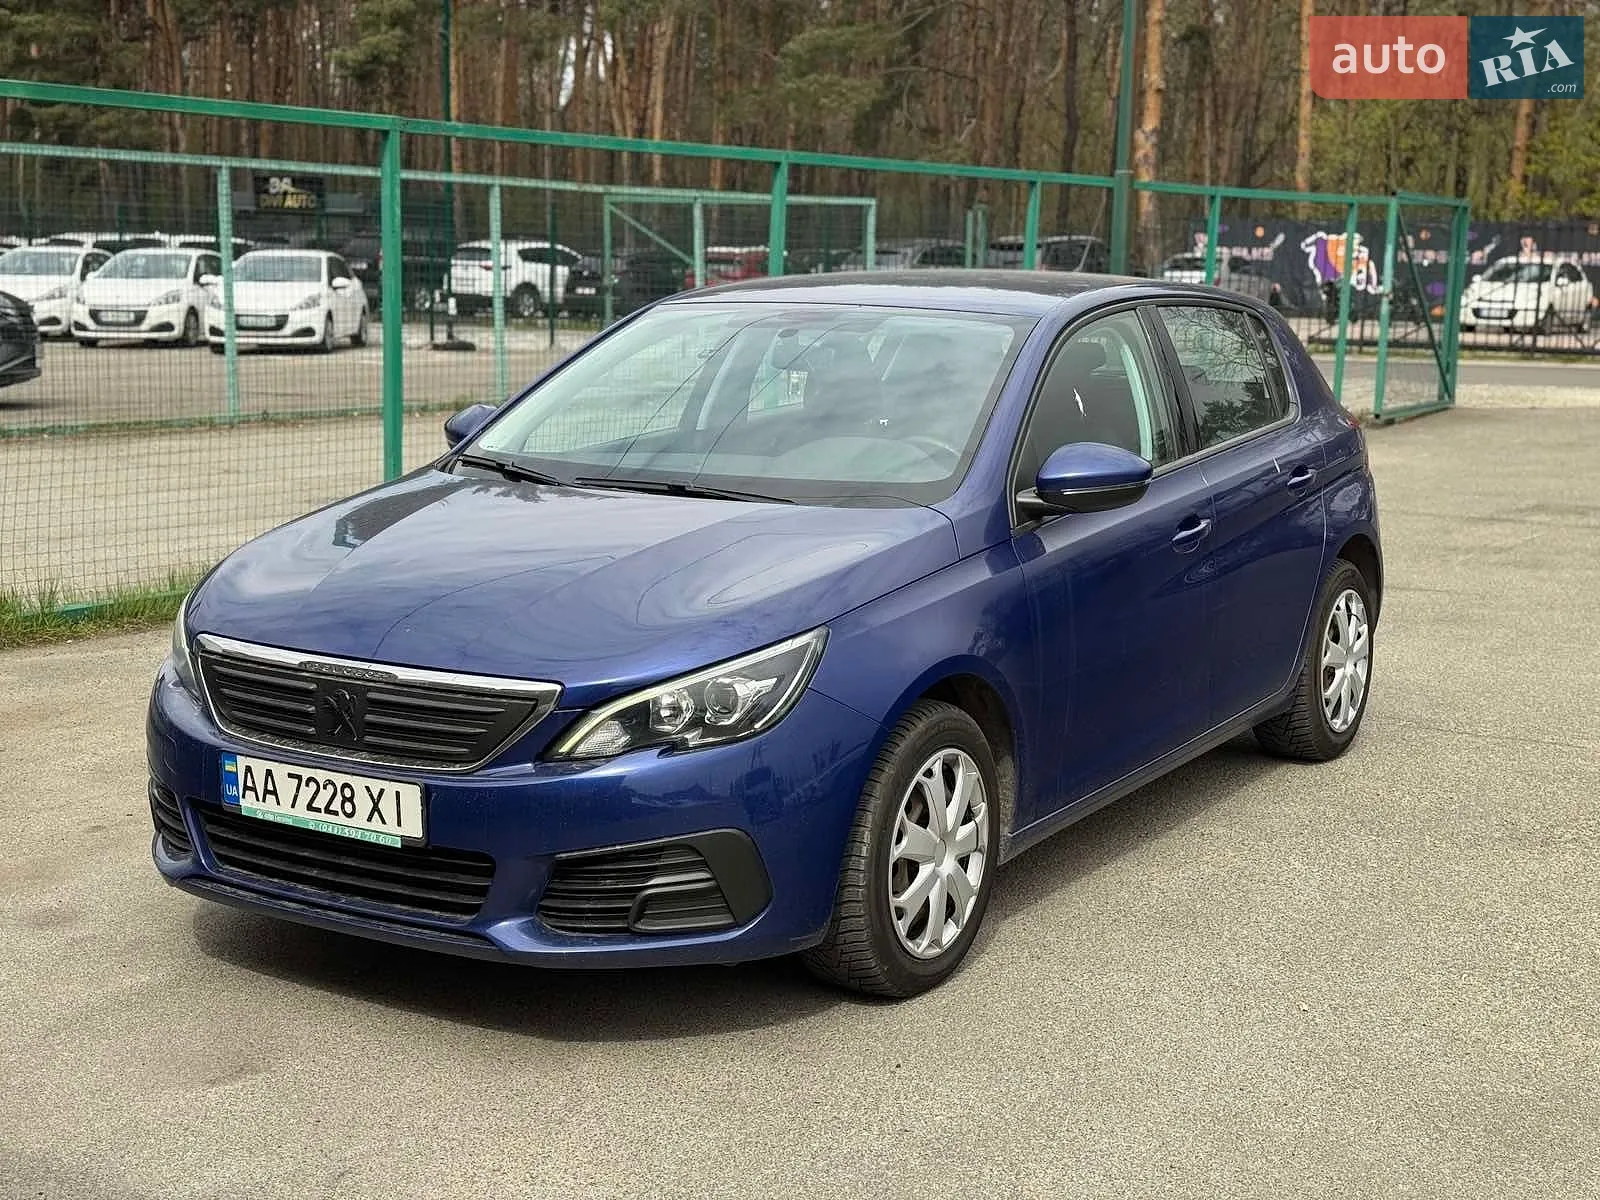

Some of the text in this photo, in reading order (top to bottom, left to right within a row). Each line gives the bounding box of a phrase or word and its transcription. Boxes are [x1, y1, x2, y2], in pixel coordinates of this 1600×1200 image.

[283, 193, 317, 208] AUTO
[225, 783, 239, 797] UA
[241, 764, 402, 828] AA 7228 XI
